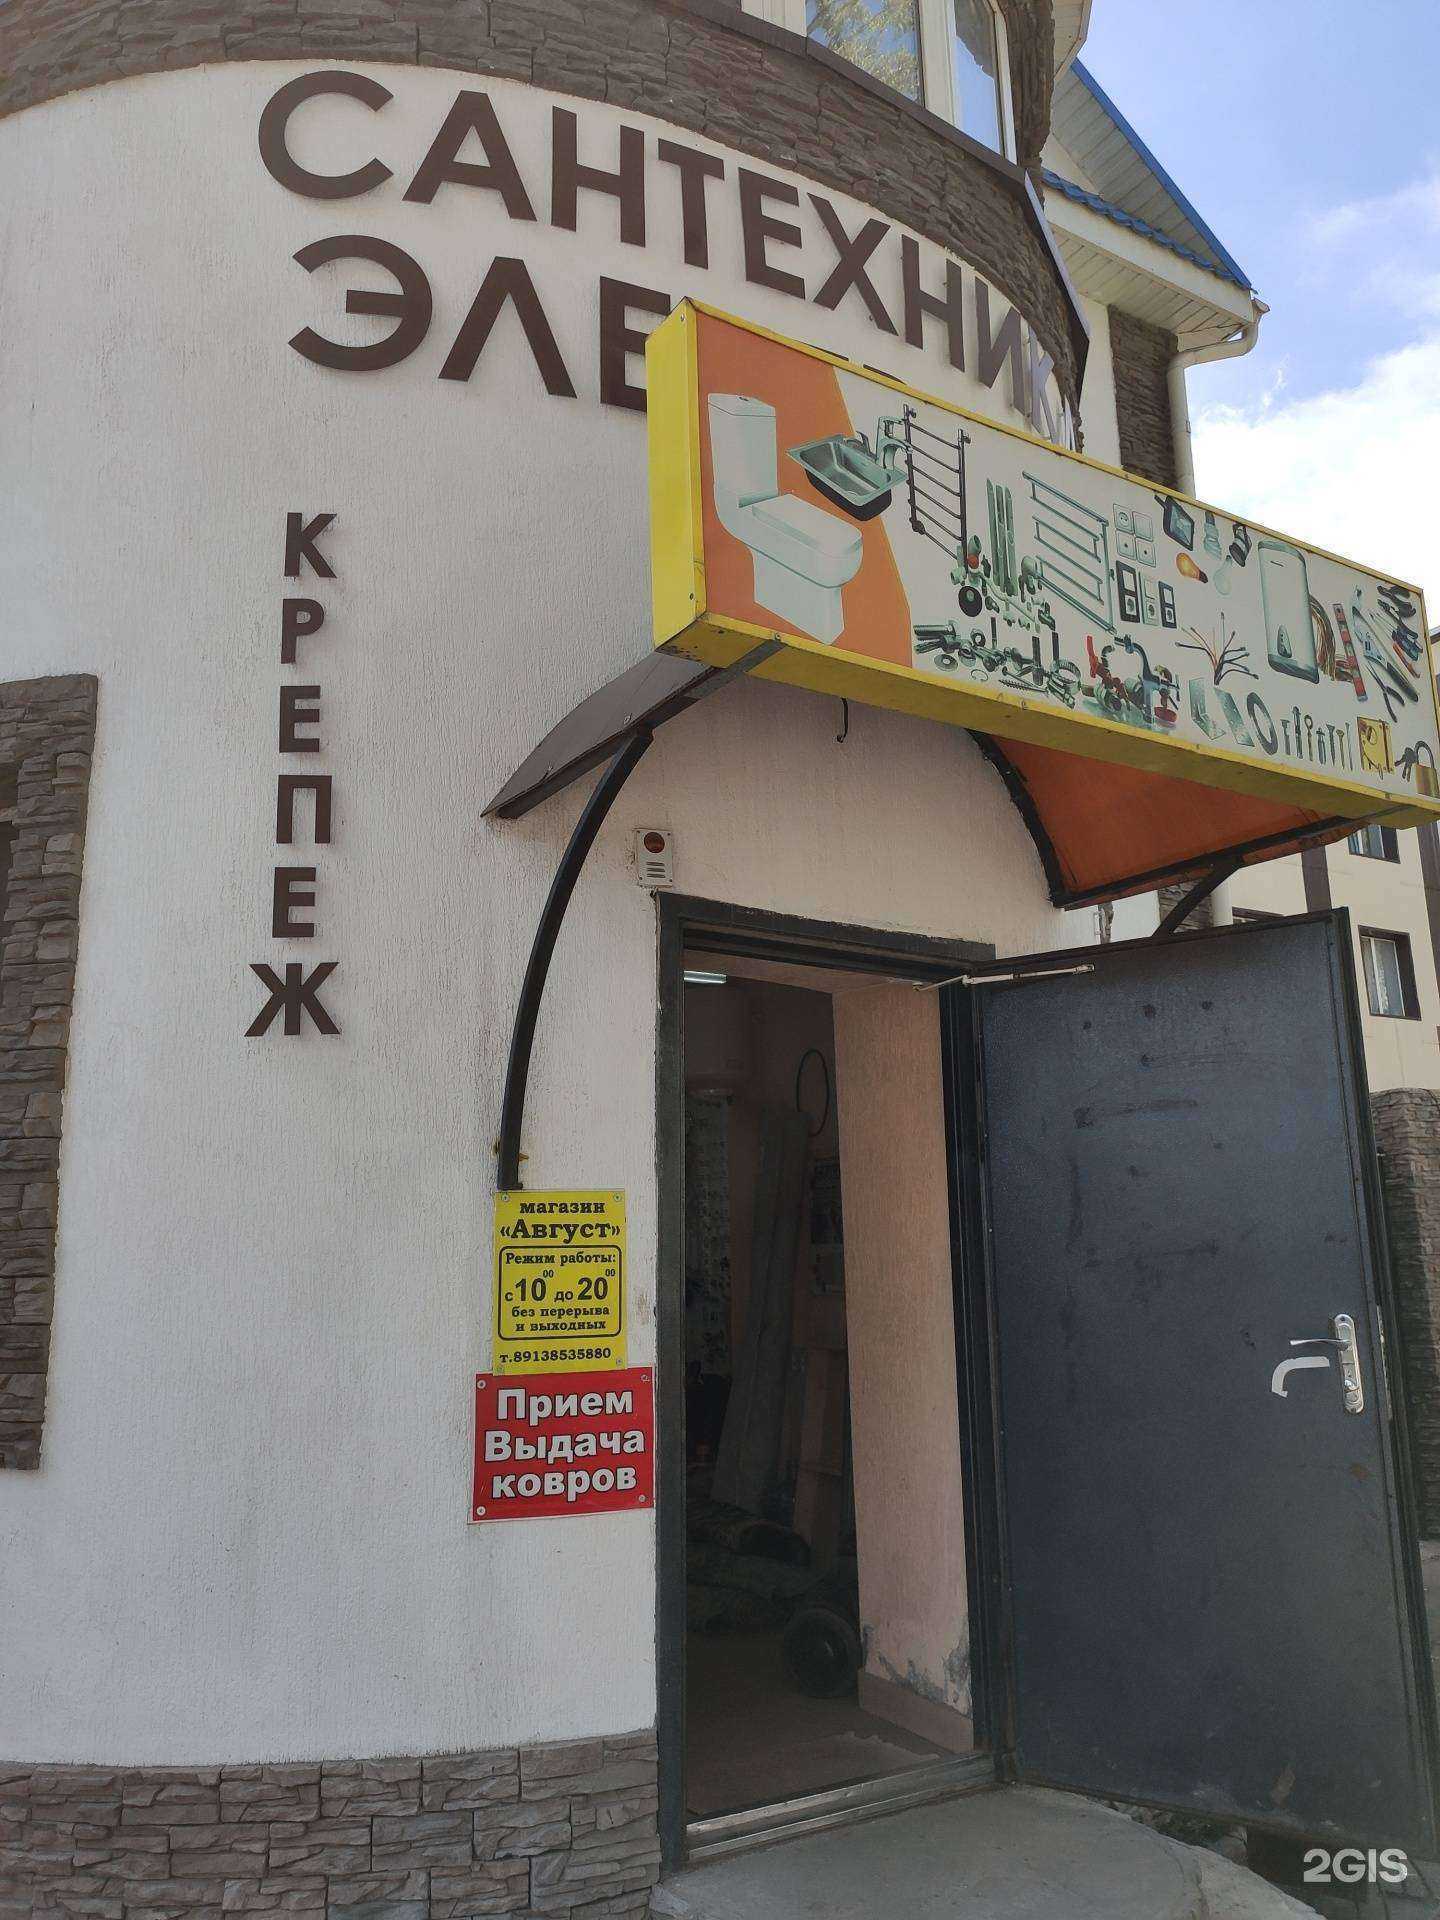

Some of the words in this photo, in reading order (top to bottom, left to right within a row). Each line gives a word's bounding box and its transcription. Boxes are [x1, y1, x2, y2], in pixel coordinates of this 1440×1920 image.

[258, 69, 1076, 450] САНТЕХНИК
[288, 234, 671, 412] ЭЛЕ
[244, 511, 341, 1037] КРЕПЕЖ
[519, 1202, 606, 1214] магазин
[500, 1218, 621, 1244] «Август»
[505, 1252, 556, 1265] Режим
[559, 1251, 616, 1266] работы:
[512, 1306, 536, 1317] без
[540, 1306, 610, 1319] перерыва
[554, 1291, 574, 1303] до
[530, 1320, 606, 1332] выходных
[496, 1387, 634, 1427] Прием
[483, 1429, 646, 1465] Выдача
[491, 1466, 638, 1502] ковров
